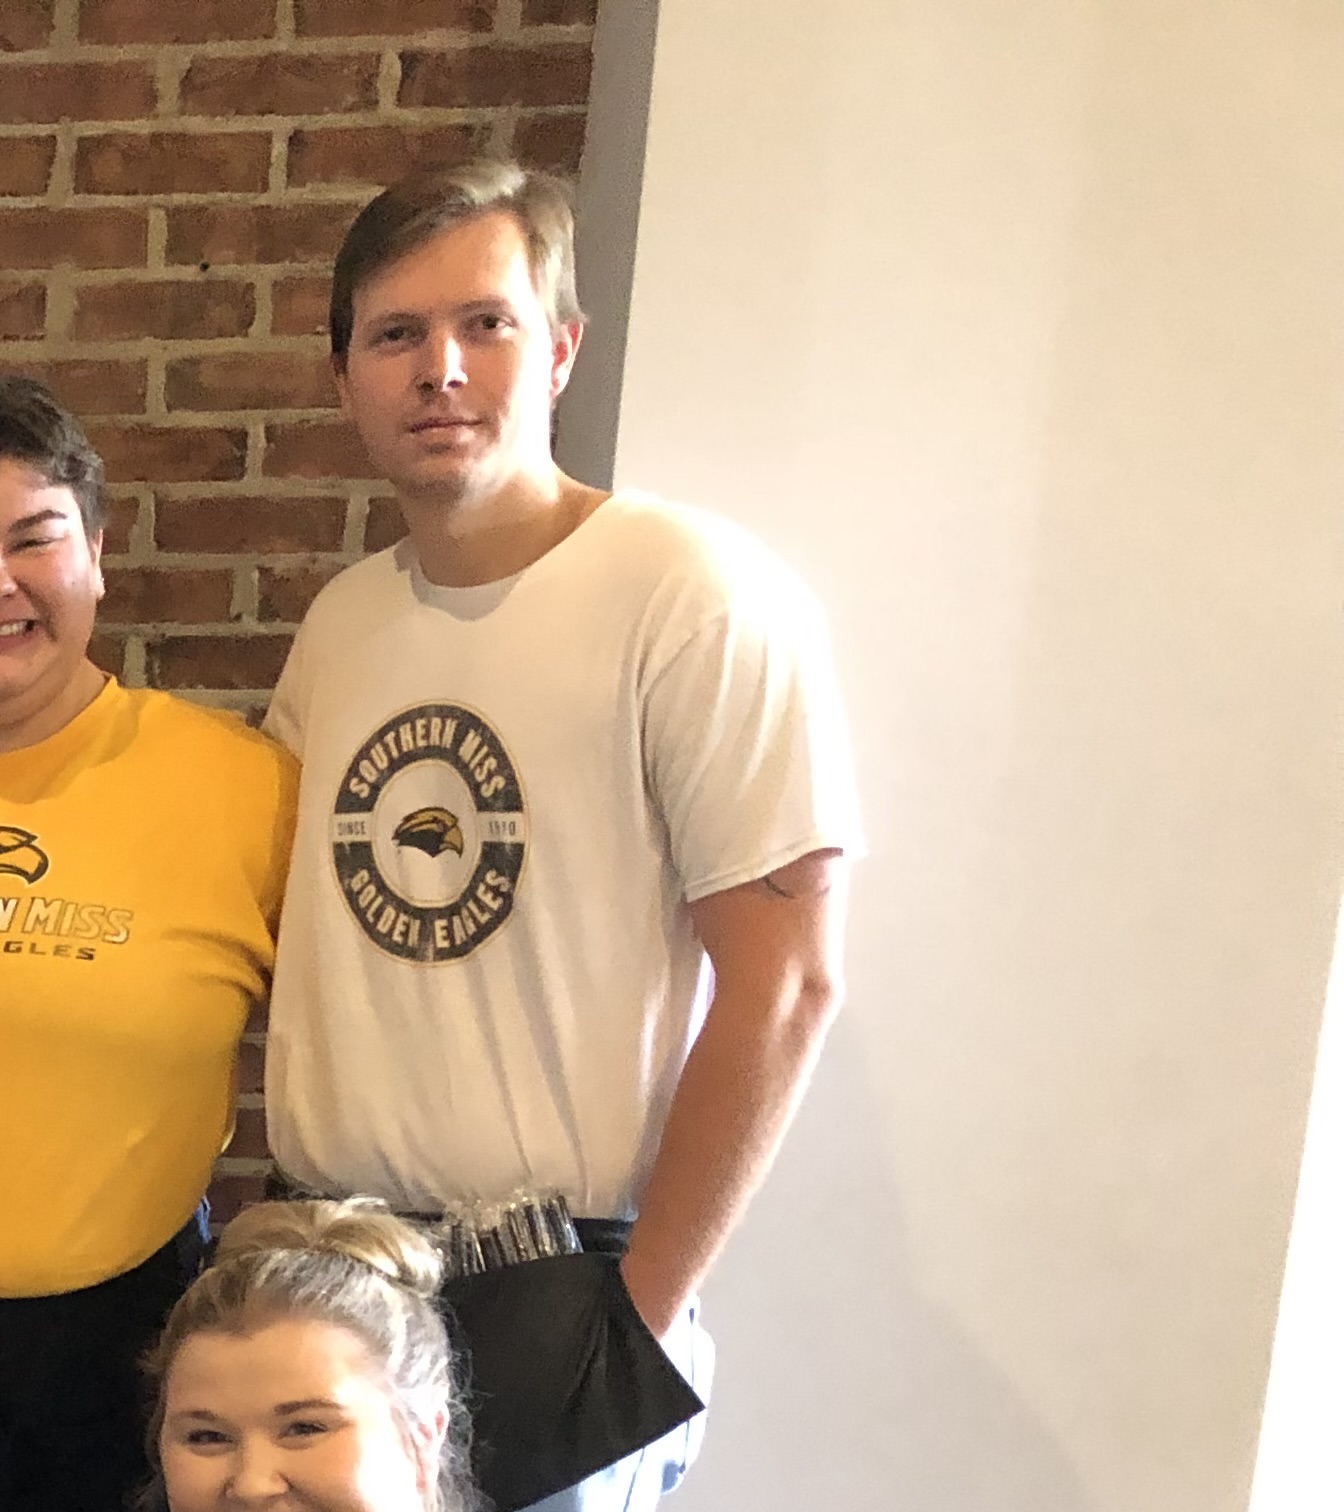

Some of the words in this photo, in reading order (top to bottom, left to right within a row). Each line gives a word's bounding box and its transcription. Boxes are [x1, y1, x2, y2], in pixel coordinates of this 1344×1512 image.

[349, 716, 459, 799] SOUTHERN
[459, 728, 506, 799] MISS
[21, 896, 136, 945] MISS
